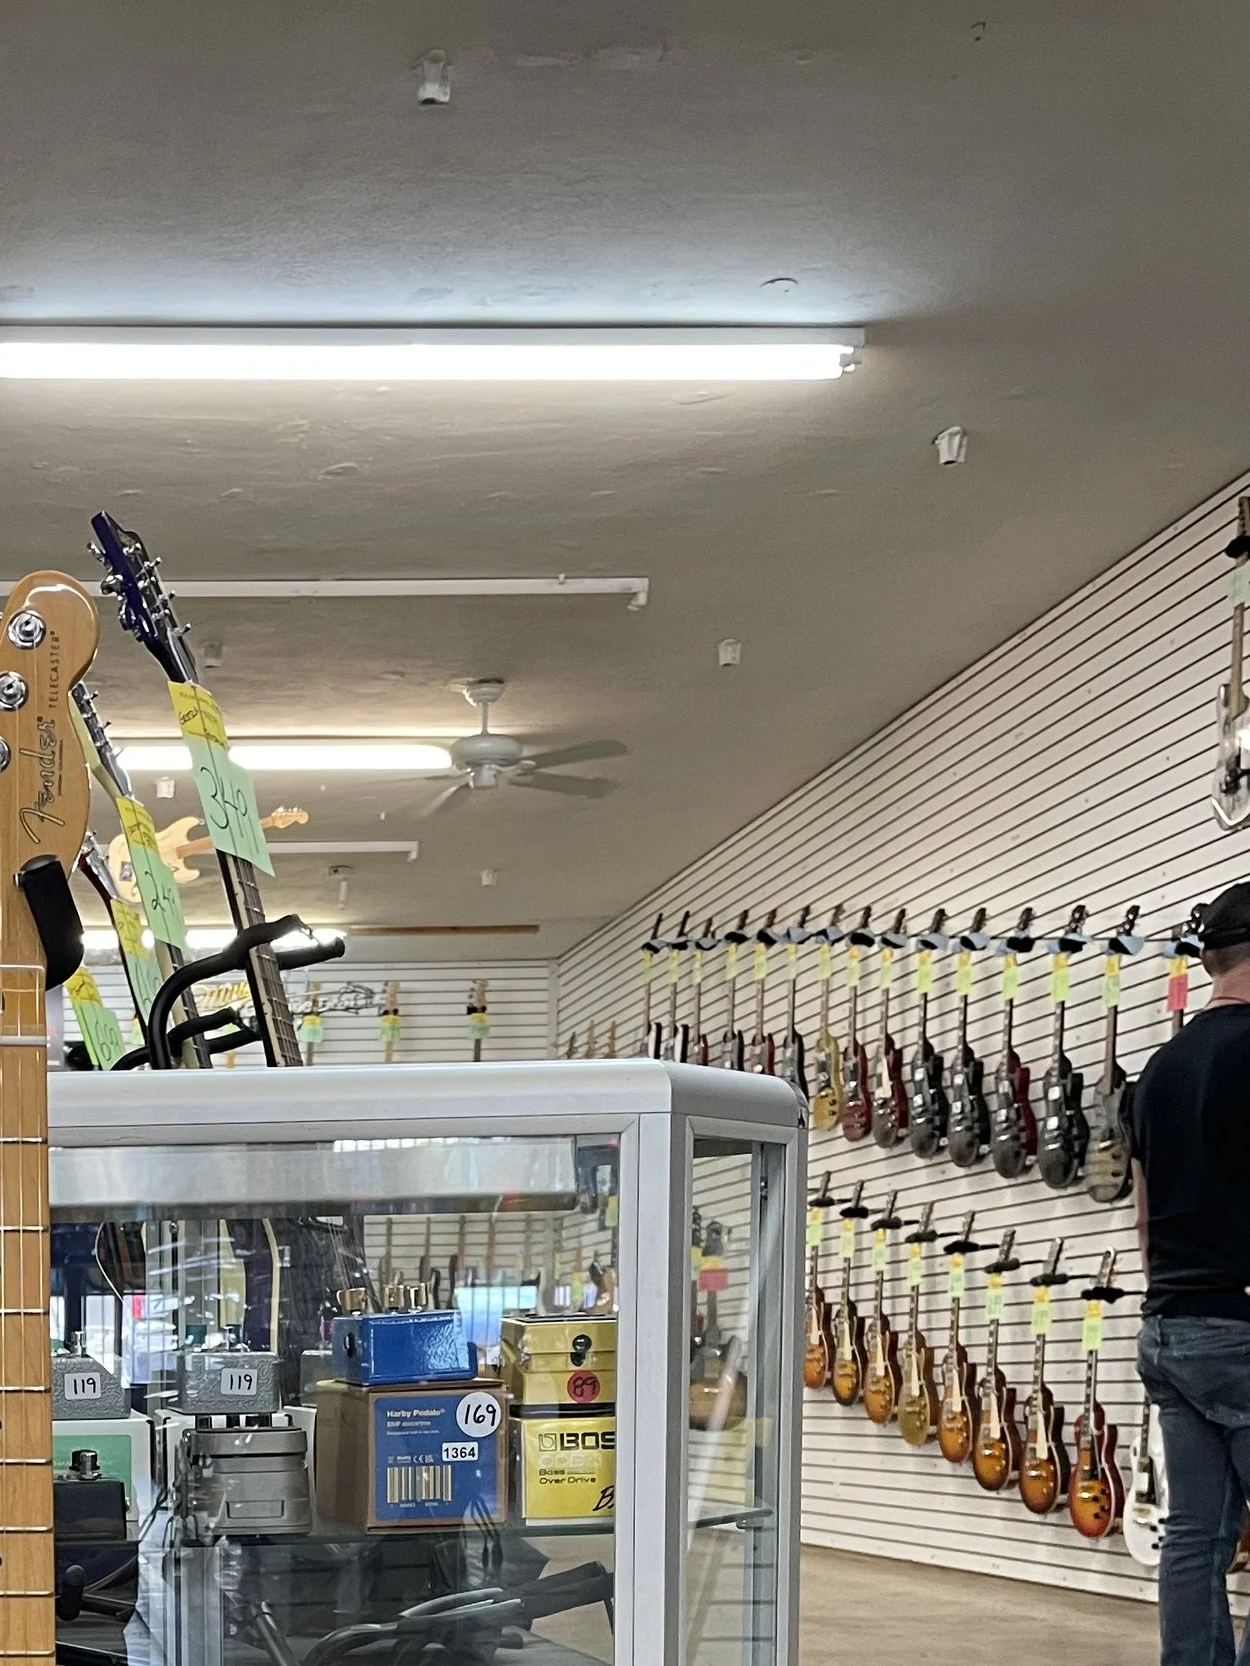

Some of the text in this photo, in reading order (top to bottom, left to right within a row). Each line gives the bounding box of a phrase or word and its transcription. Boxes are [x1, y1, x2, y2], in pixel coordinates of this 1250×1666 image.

[48, 636, 61, 709] TELECASTER
[19, 719, 65, 845] Fender
[72, 1376, 97, 1395] 119
[230, 1373, 253, 1392] 119
[572, 1376, 598, 1398] 89
[464, 1404, 497, 1427] 169
[443, 1446, 476, 1459] 1364
[539, 1477, 566, 1485] Over
